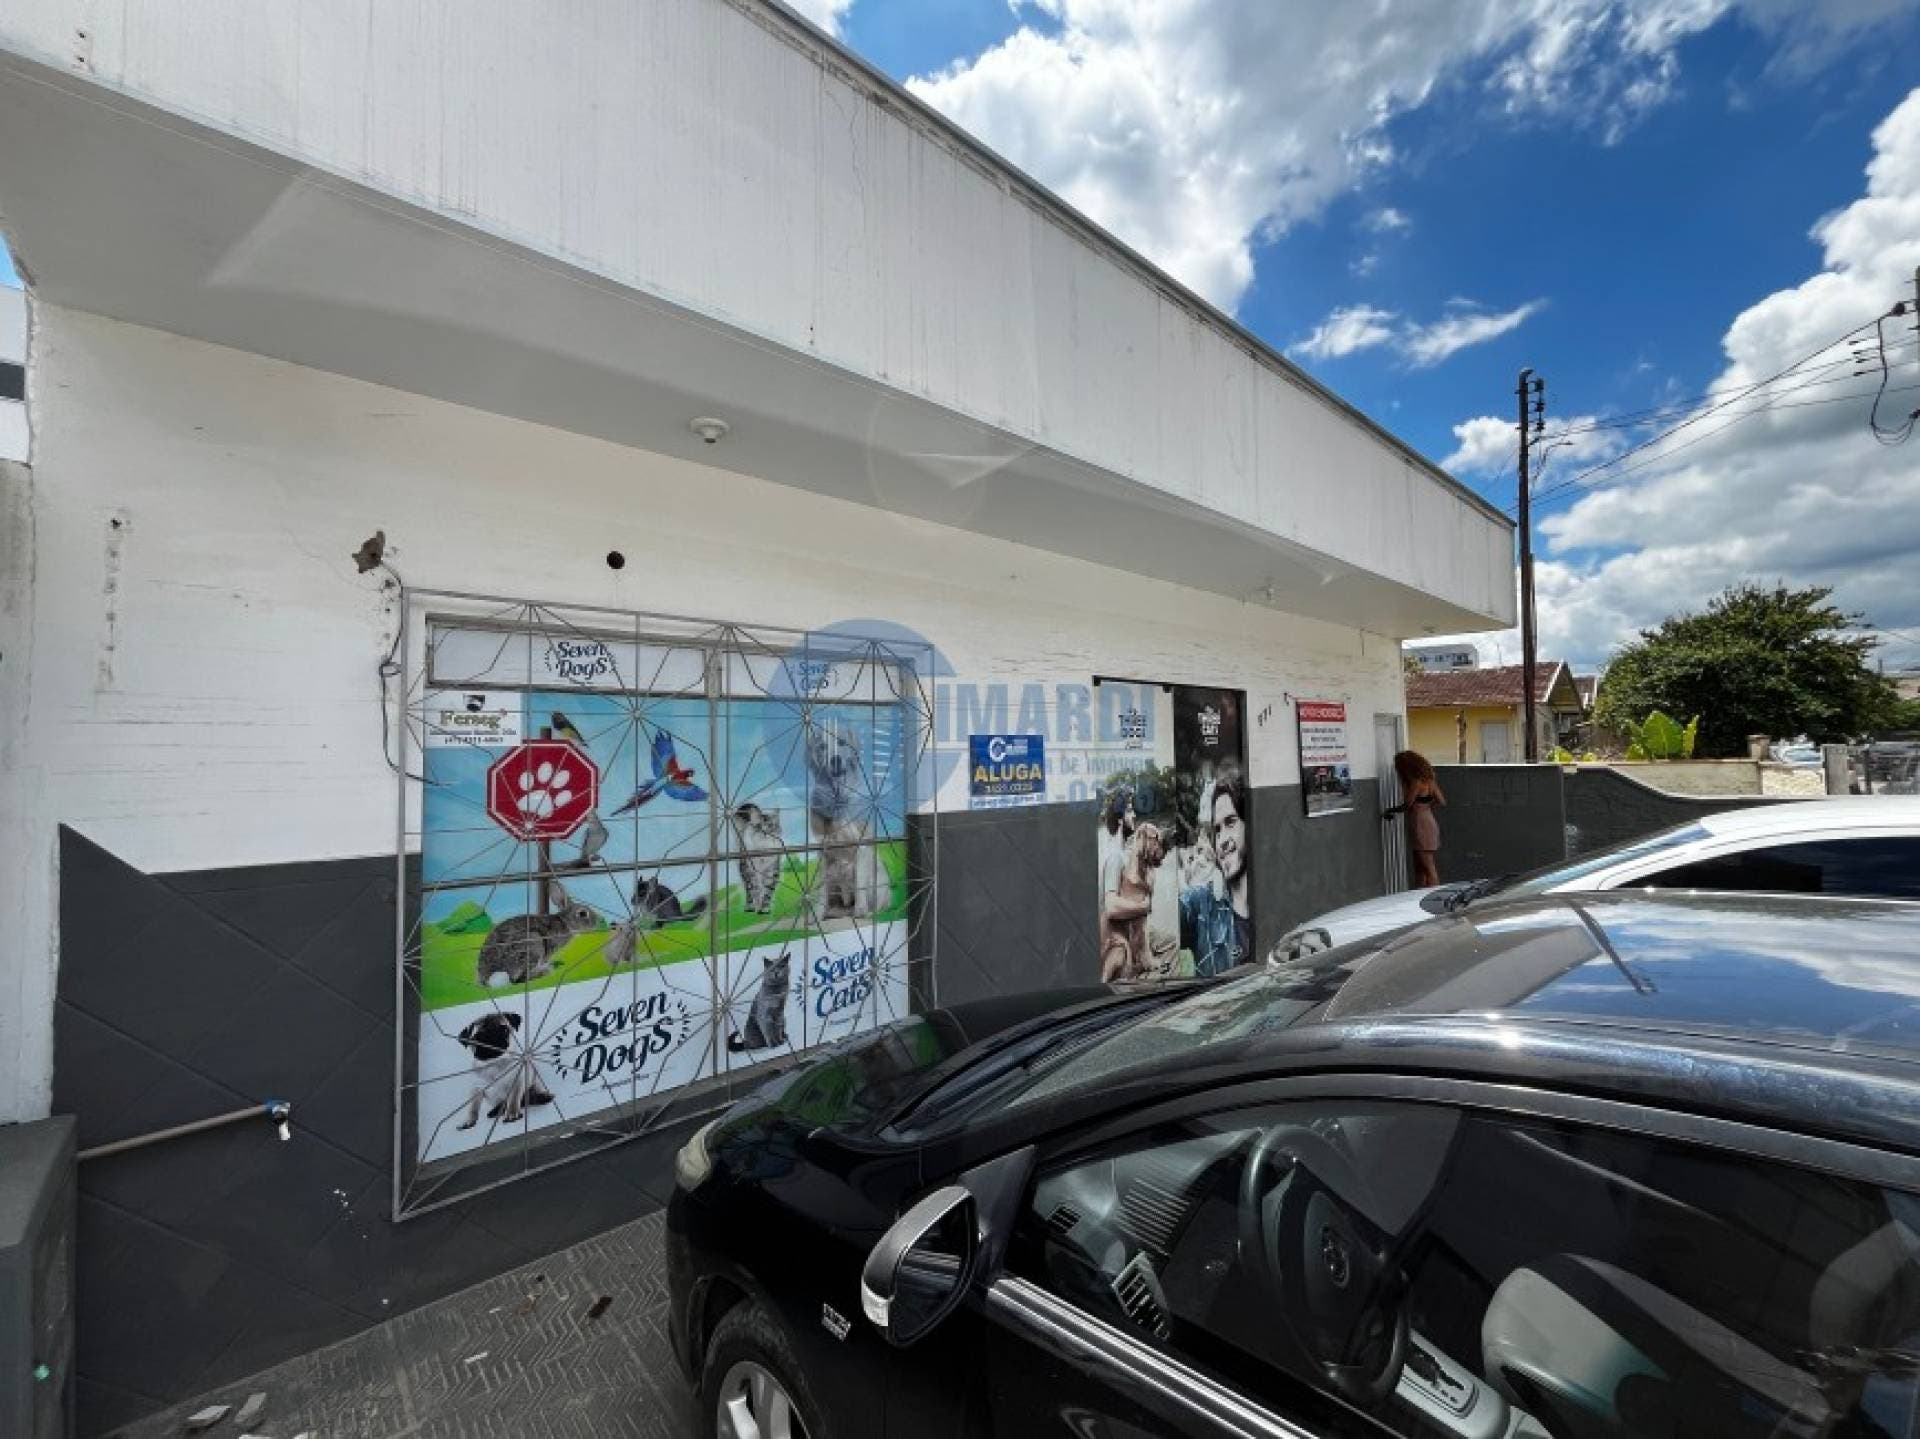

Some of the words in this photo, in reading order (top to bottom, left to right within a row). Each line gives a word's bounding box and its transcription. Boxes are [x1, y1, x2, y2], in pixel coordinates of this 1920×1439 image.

[557, 641, 608, 658] Seven
[974, 763, 1042, 782] ALUGA
[812, 946, 877, 989] Seven
[575, 991, 671, 1047] Seven
